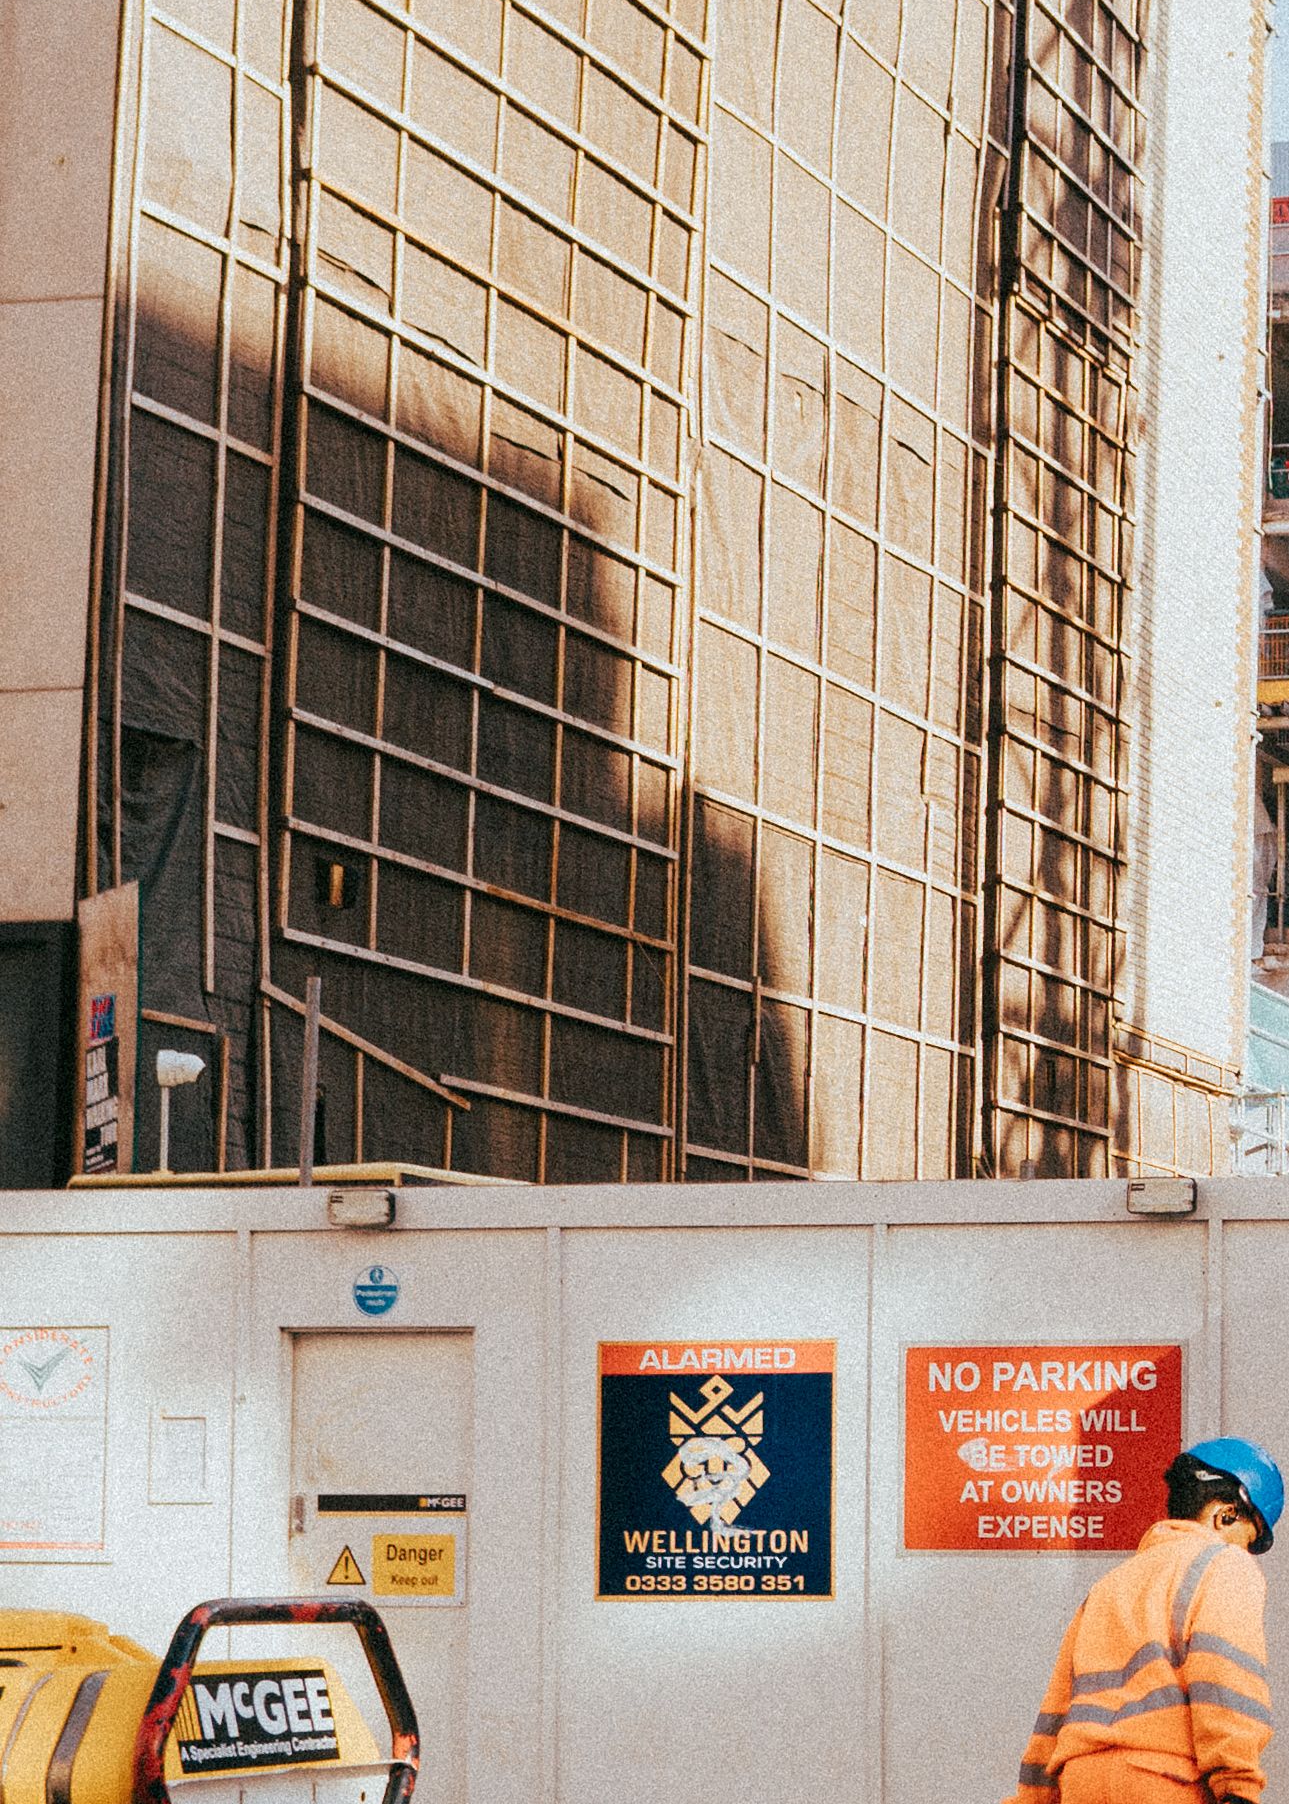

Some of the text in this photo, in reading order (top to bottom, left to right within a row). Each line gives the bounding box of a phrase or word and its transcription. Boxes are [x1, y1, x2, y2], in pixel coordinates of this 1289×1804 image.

[639, 1347, 796, 1371] ALARMED
[928, 1360, 1157, 1392] NO PARKING
[938, 1409, 1146, 1433] VEHICLES WILL
[973, 1444, 1113, 1468] BE TOWED
[960, 1481, 1122, 1503] AT OWNERS
[978, 1515, 1104, 1538] EXPENSE
[623, 1529, 809, 1553] WELLINGTON
[386, 1544, 444, 1565] Danger
[646, 1556, 788, 1569] SITE SECURITY
[391, 1575, 439, 1587] Keep out
[625, 1575, 805, 1591] 0333 3580 351
[194, 1677, 335, 1740] McGEE
[181, 1736, 338, 1764] A Specialist Engineering Contractor
